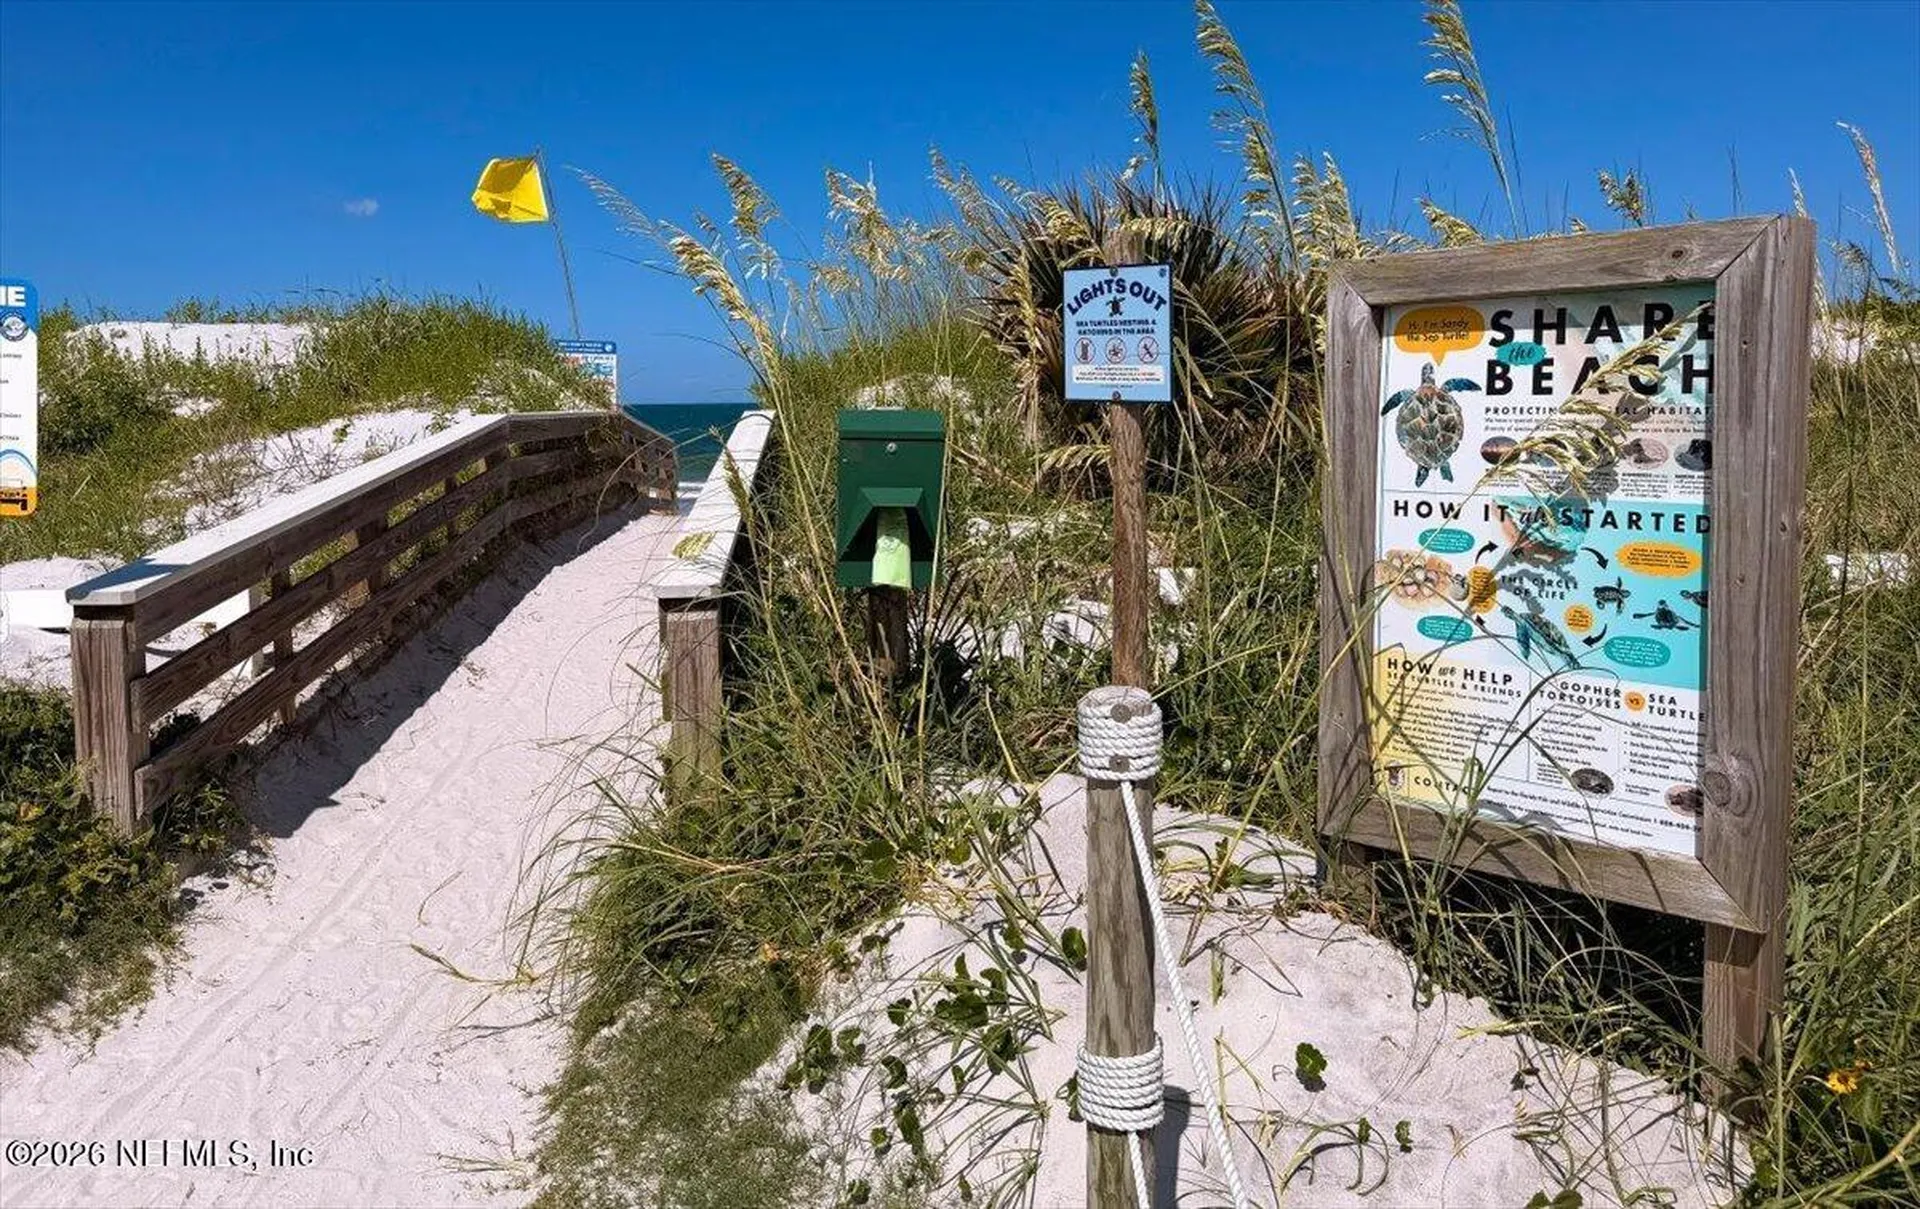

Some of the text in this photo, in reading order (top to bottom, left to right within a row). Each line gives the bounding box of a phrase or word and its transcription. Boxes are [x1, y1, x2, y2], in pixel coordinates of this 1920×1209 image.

[1067, 278, 1167, 315] LIGHTS OUT
[1441, 318, 1470, 329] Sandy
[1489, 300, 1715, 348] SHARE
[1508, 344, 1535, 362] the
[1486, 353, 1714, 396] BEACH
[1484, 406, 1559, 415] PROTECTIN
[1393, 499, 1462, 520] HOW
[1484, 504, 1510, 522] IT
[1561, 508, 1711, 534] STARTED
[1501, 575, 1578, 590] THE CIRCLE
[1514, 586, 1566, 600] OF LIFE
[1387, 658, 1433, 675] HOW
[1463, 668, 1513, 686] HELP
[1474, 684, 1522, 698] FRIENDS
[1559, 680, 1622, 698] GOPHER
[1538, 688, 1621, 710] TORTOISES
[1648, 693, 1678, 706] SEA
[1648, 705, 1706, 722] TURTLE
